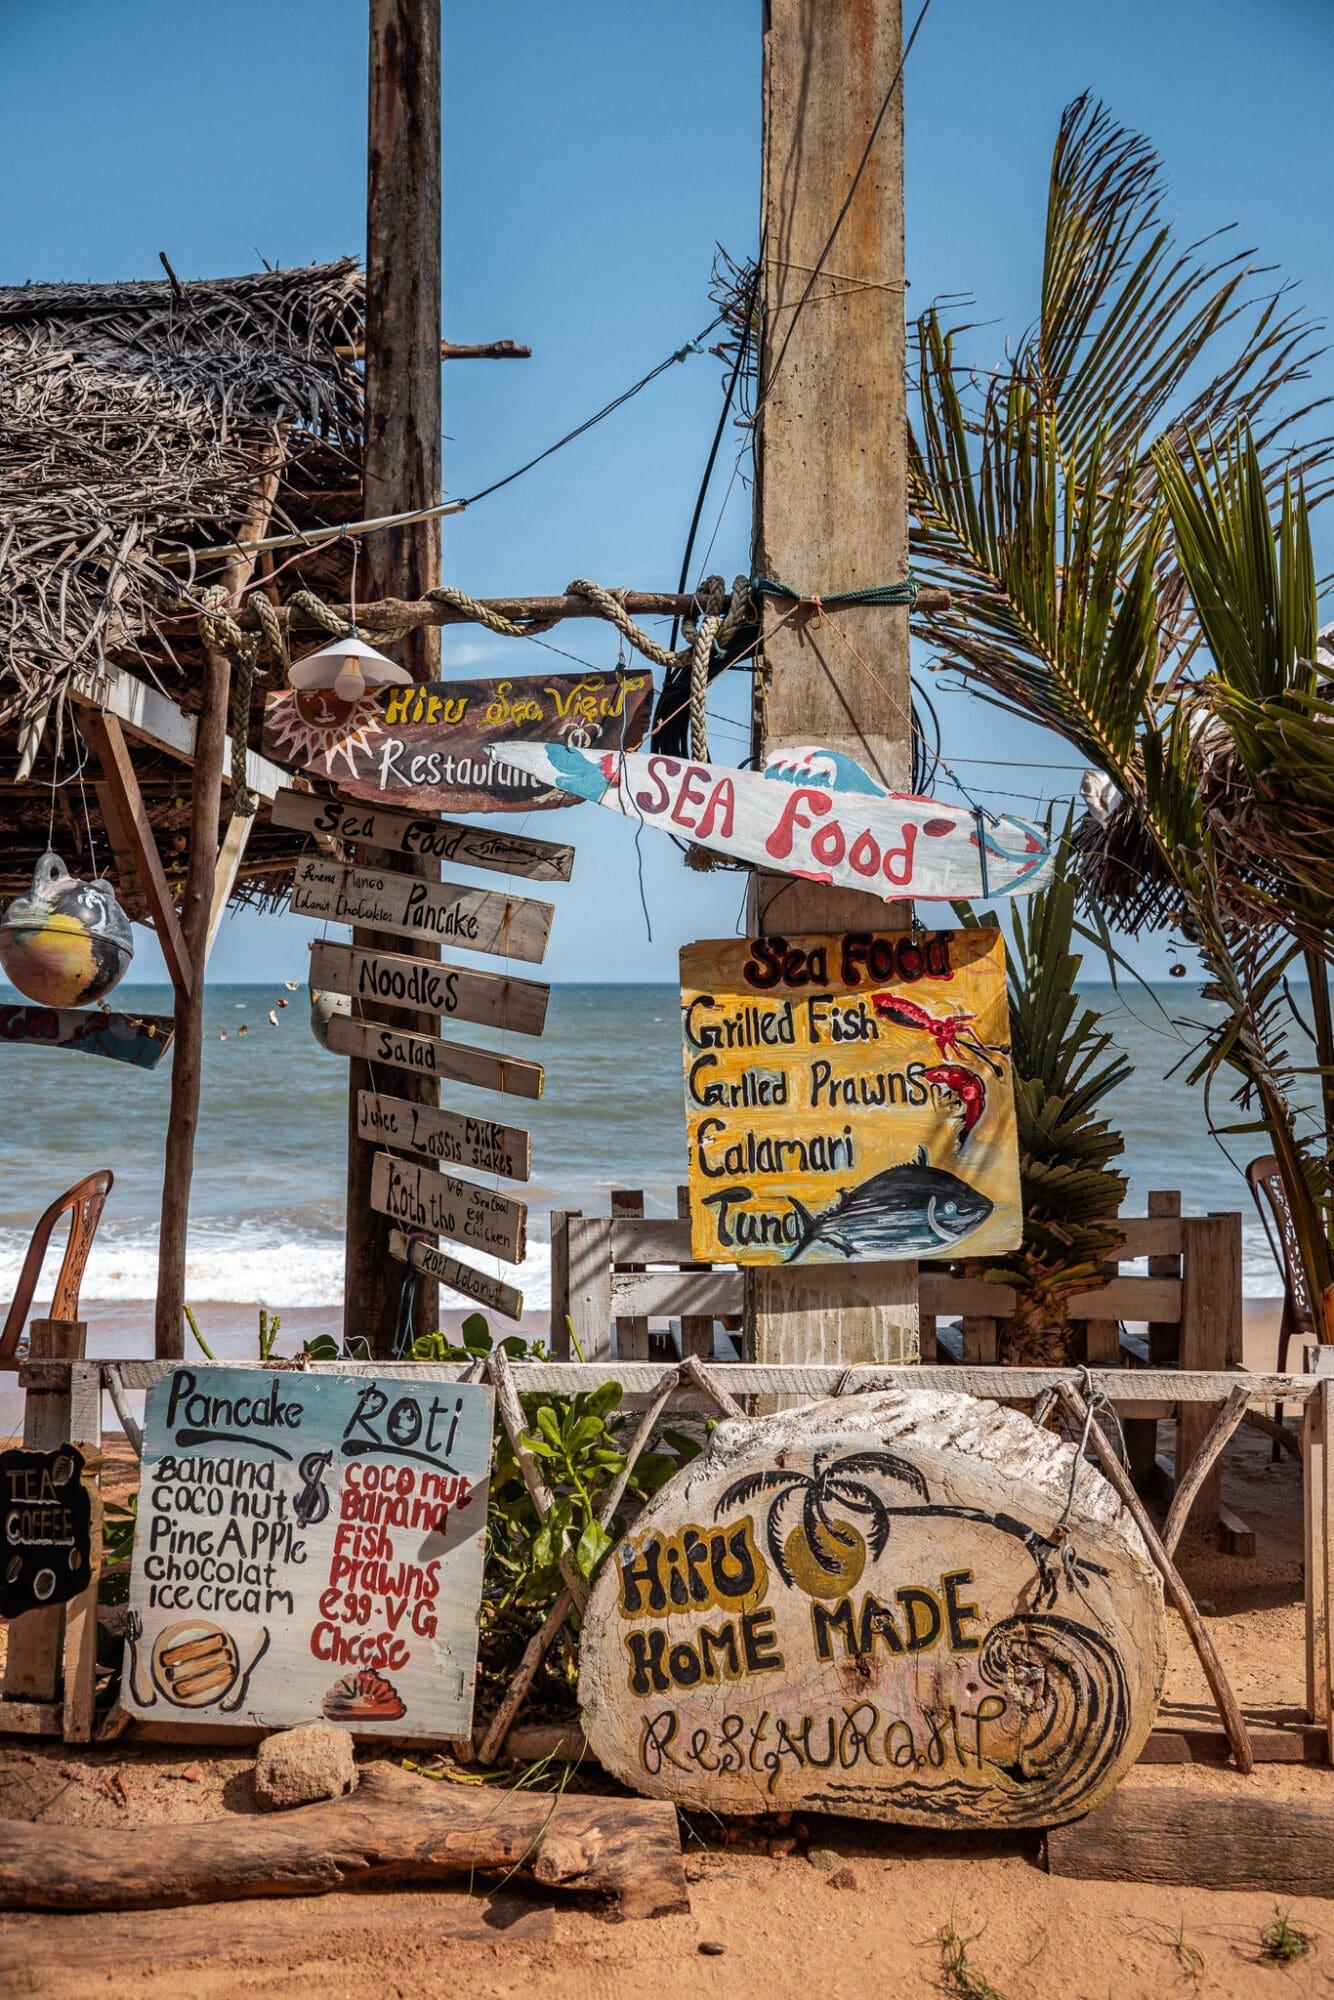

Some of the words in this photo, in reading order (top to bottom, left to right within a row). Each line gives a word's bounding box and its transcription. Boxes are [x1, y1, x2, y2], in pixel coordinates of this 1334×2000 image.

[476, 681, 543, 727] Sea
[636, 756, 733, 839] SEA
[313, 804, 375, 838] Sea
[400, 821, 469, 860] Food
[402, 883, 480, 939] Pancake
[743, 936, 829, 989] Sea
[685, 995, 795, 1050] Grilled
[808, 994, 880, 1043] Fish
[377, 1031, 437, 1070] Salad
[411, 1109, 462, 1161] Lassis
[698, 1117, 856, 1178] Calamari
[701, 1186, 800, 1247] Tuna
[166, 1370, 304, 1429] Pancake
[5, 1468, 57, 1499] TEA
[152, 1455, 275, 1492] Banana
[6, 1508, 74, 1541] COFFEE
[340, 1488, 449, 1536] Banana
[333, 1523, 393, 1561] Fish
[813, 1571, 982, 1658] MADE
